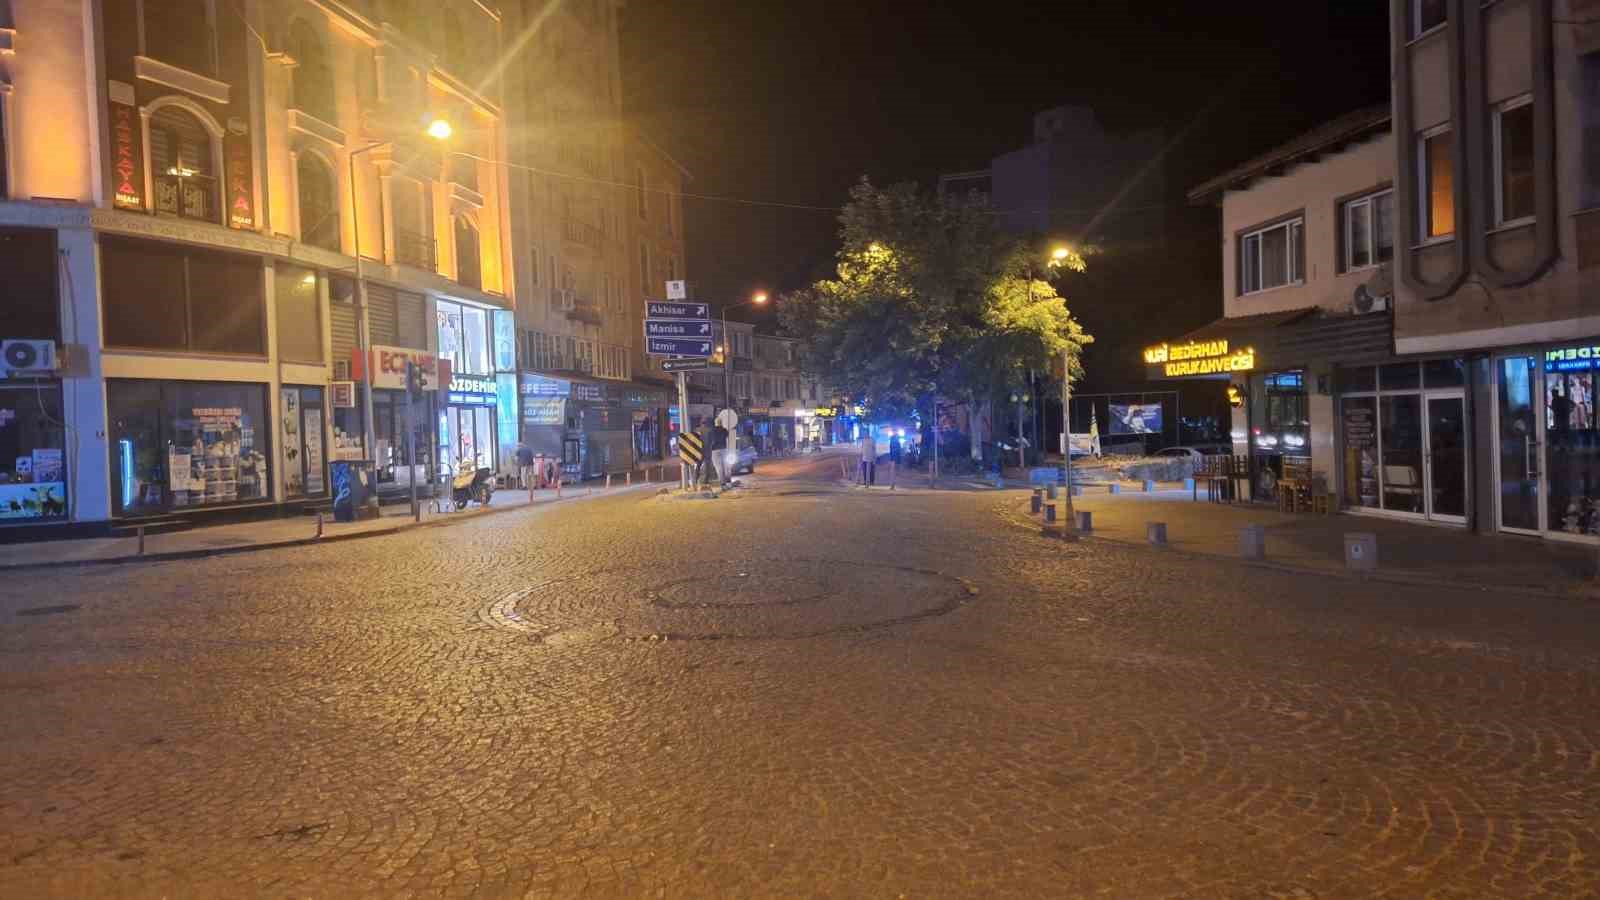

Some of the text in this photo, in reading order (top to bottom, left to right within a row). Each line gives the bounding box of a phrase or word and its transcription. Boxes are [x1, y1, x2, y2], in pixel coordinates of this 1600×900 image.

[650, 304, 686, 315] Akhisar
[649, 323, 685, 334] Manisa
[1144, 340, 1229, 363] NURİ BEDİRHAN
[1165, 346, 1255, 377] KURUKAHVECİSİ
[519, 383, 540, 395] EFE
